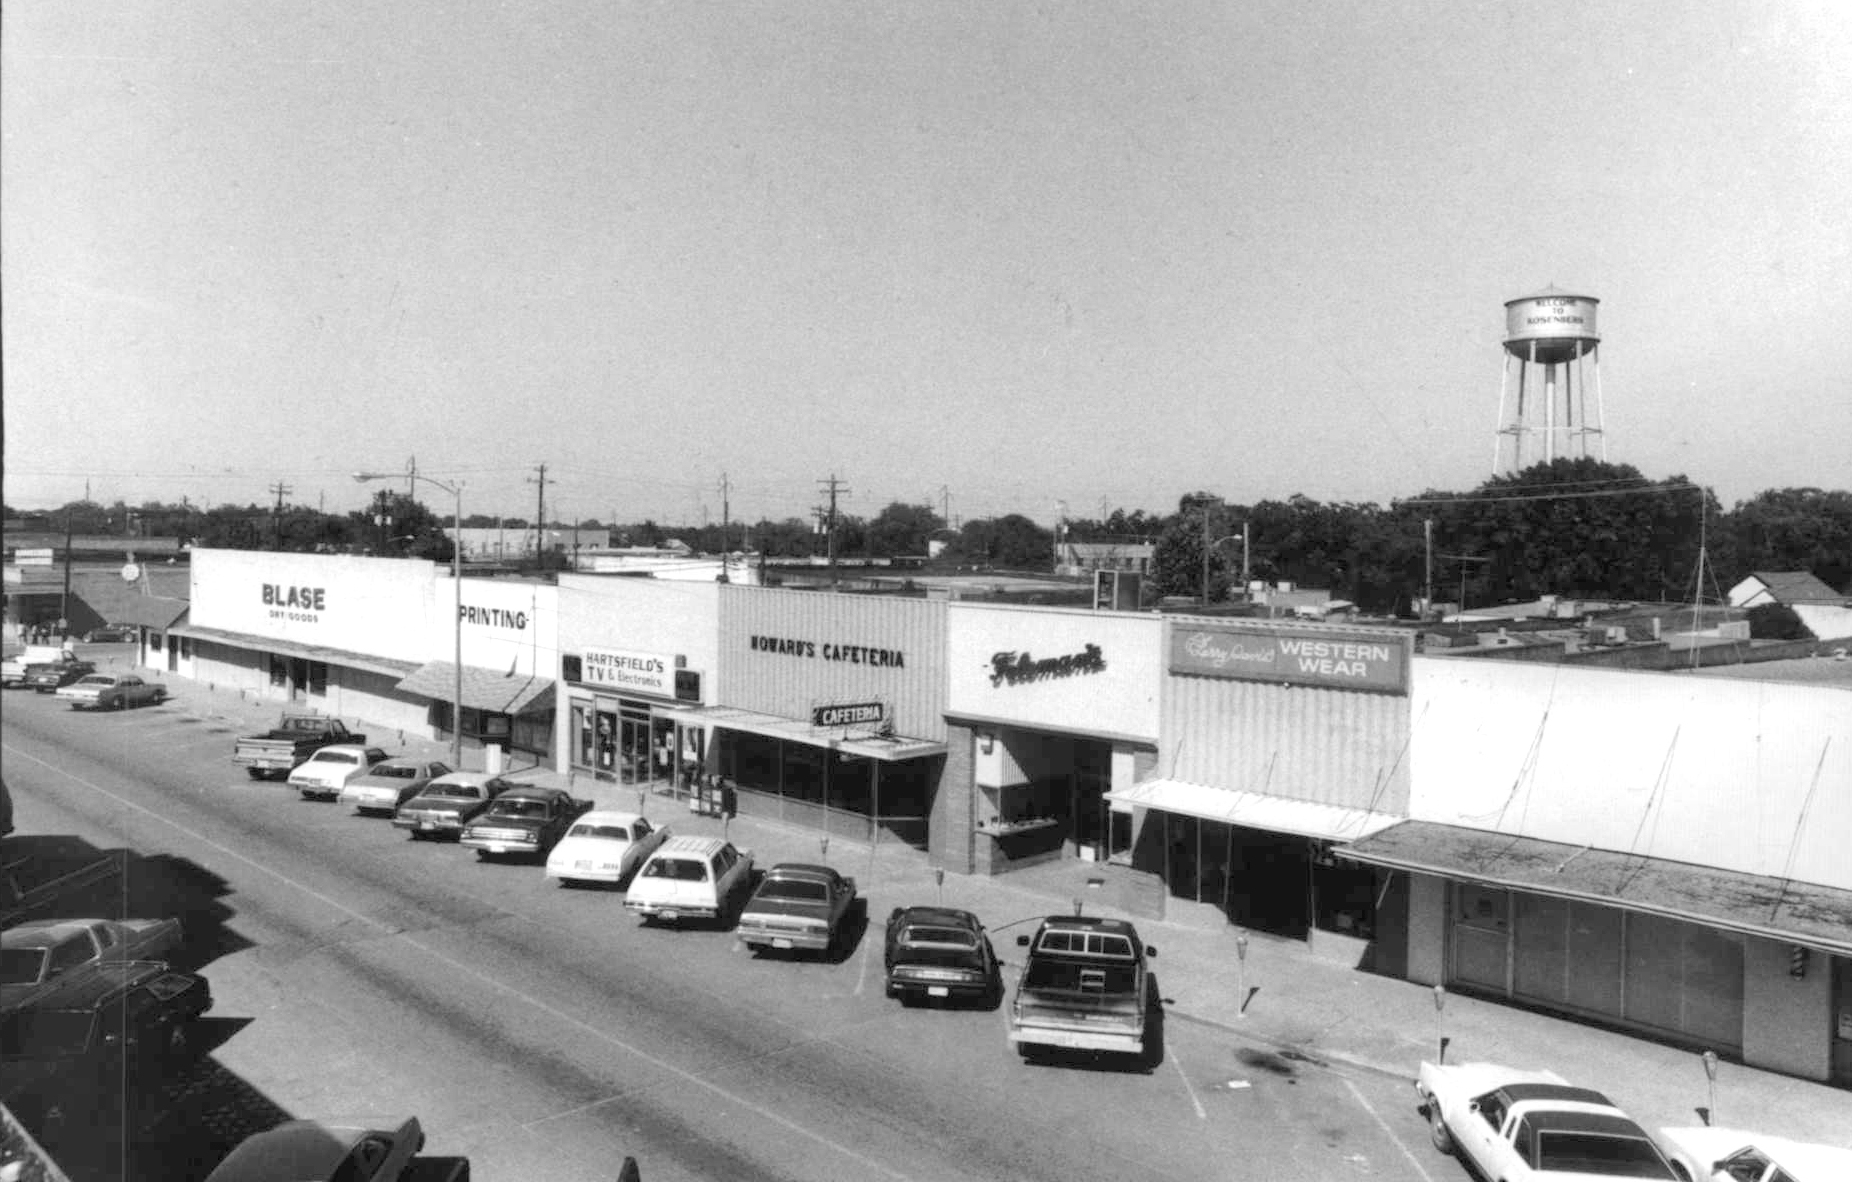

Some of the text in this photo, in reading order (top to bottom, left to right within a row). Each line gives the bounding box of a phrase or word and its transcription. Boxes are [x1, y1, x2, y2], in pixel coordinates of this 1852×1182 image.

[1552, 307, 1564, 315] TO
[262, 583, 325, 610] BLASE
[288, 612, 319, 623] GOODS
[459, 605, 526, 630] PRINTING
[751, 635, 905, 669] HOWARD'S CAFETERIA
[1280, 639, 1389, 662] WESTERN
[586, 652, 664, 673] HARTSFIELD'S
[1298, 657, 1367, 677] WEAR
[588, 665, 605, 682] TV
[617, 669, 662, 688] Electronics
[822, 705, 880, 724] CAFETERIA
